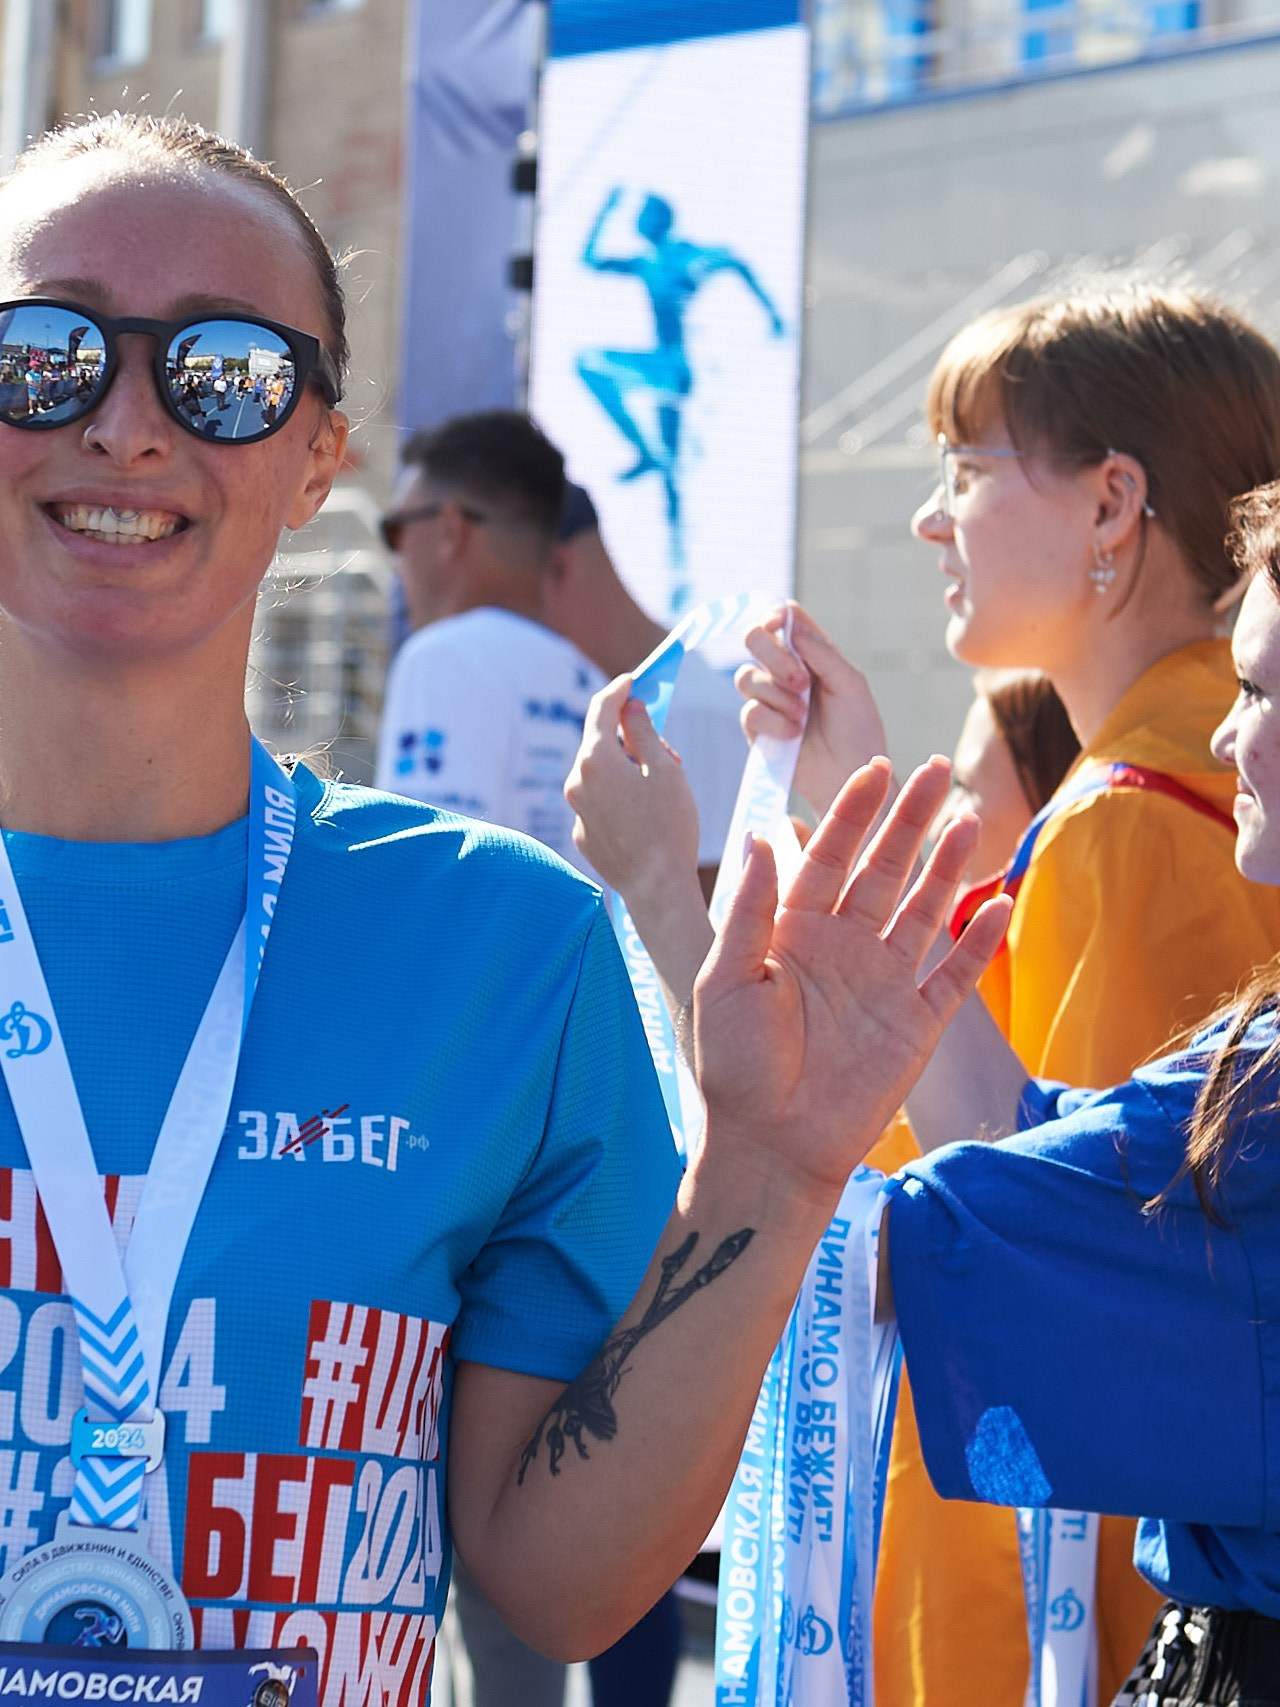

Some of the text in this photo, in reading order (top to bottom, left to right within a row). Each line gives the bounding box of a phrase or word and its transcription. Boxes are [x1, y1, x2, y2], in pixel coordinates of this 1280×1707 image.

[810, 1216, 852, 1542] ДИНАМО БЕЖИТ!
[92, 1429, 145, 1449] 2024
[52, 1542, 116, 1560] ДВИЖЕНИИ
[119, 1599, 142, 1634] МИЛЯ
